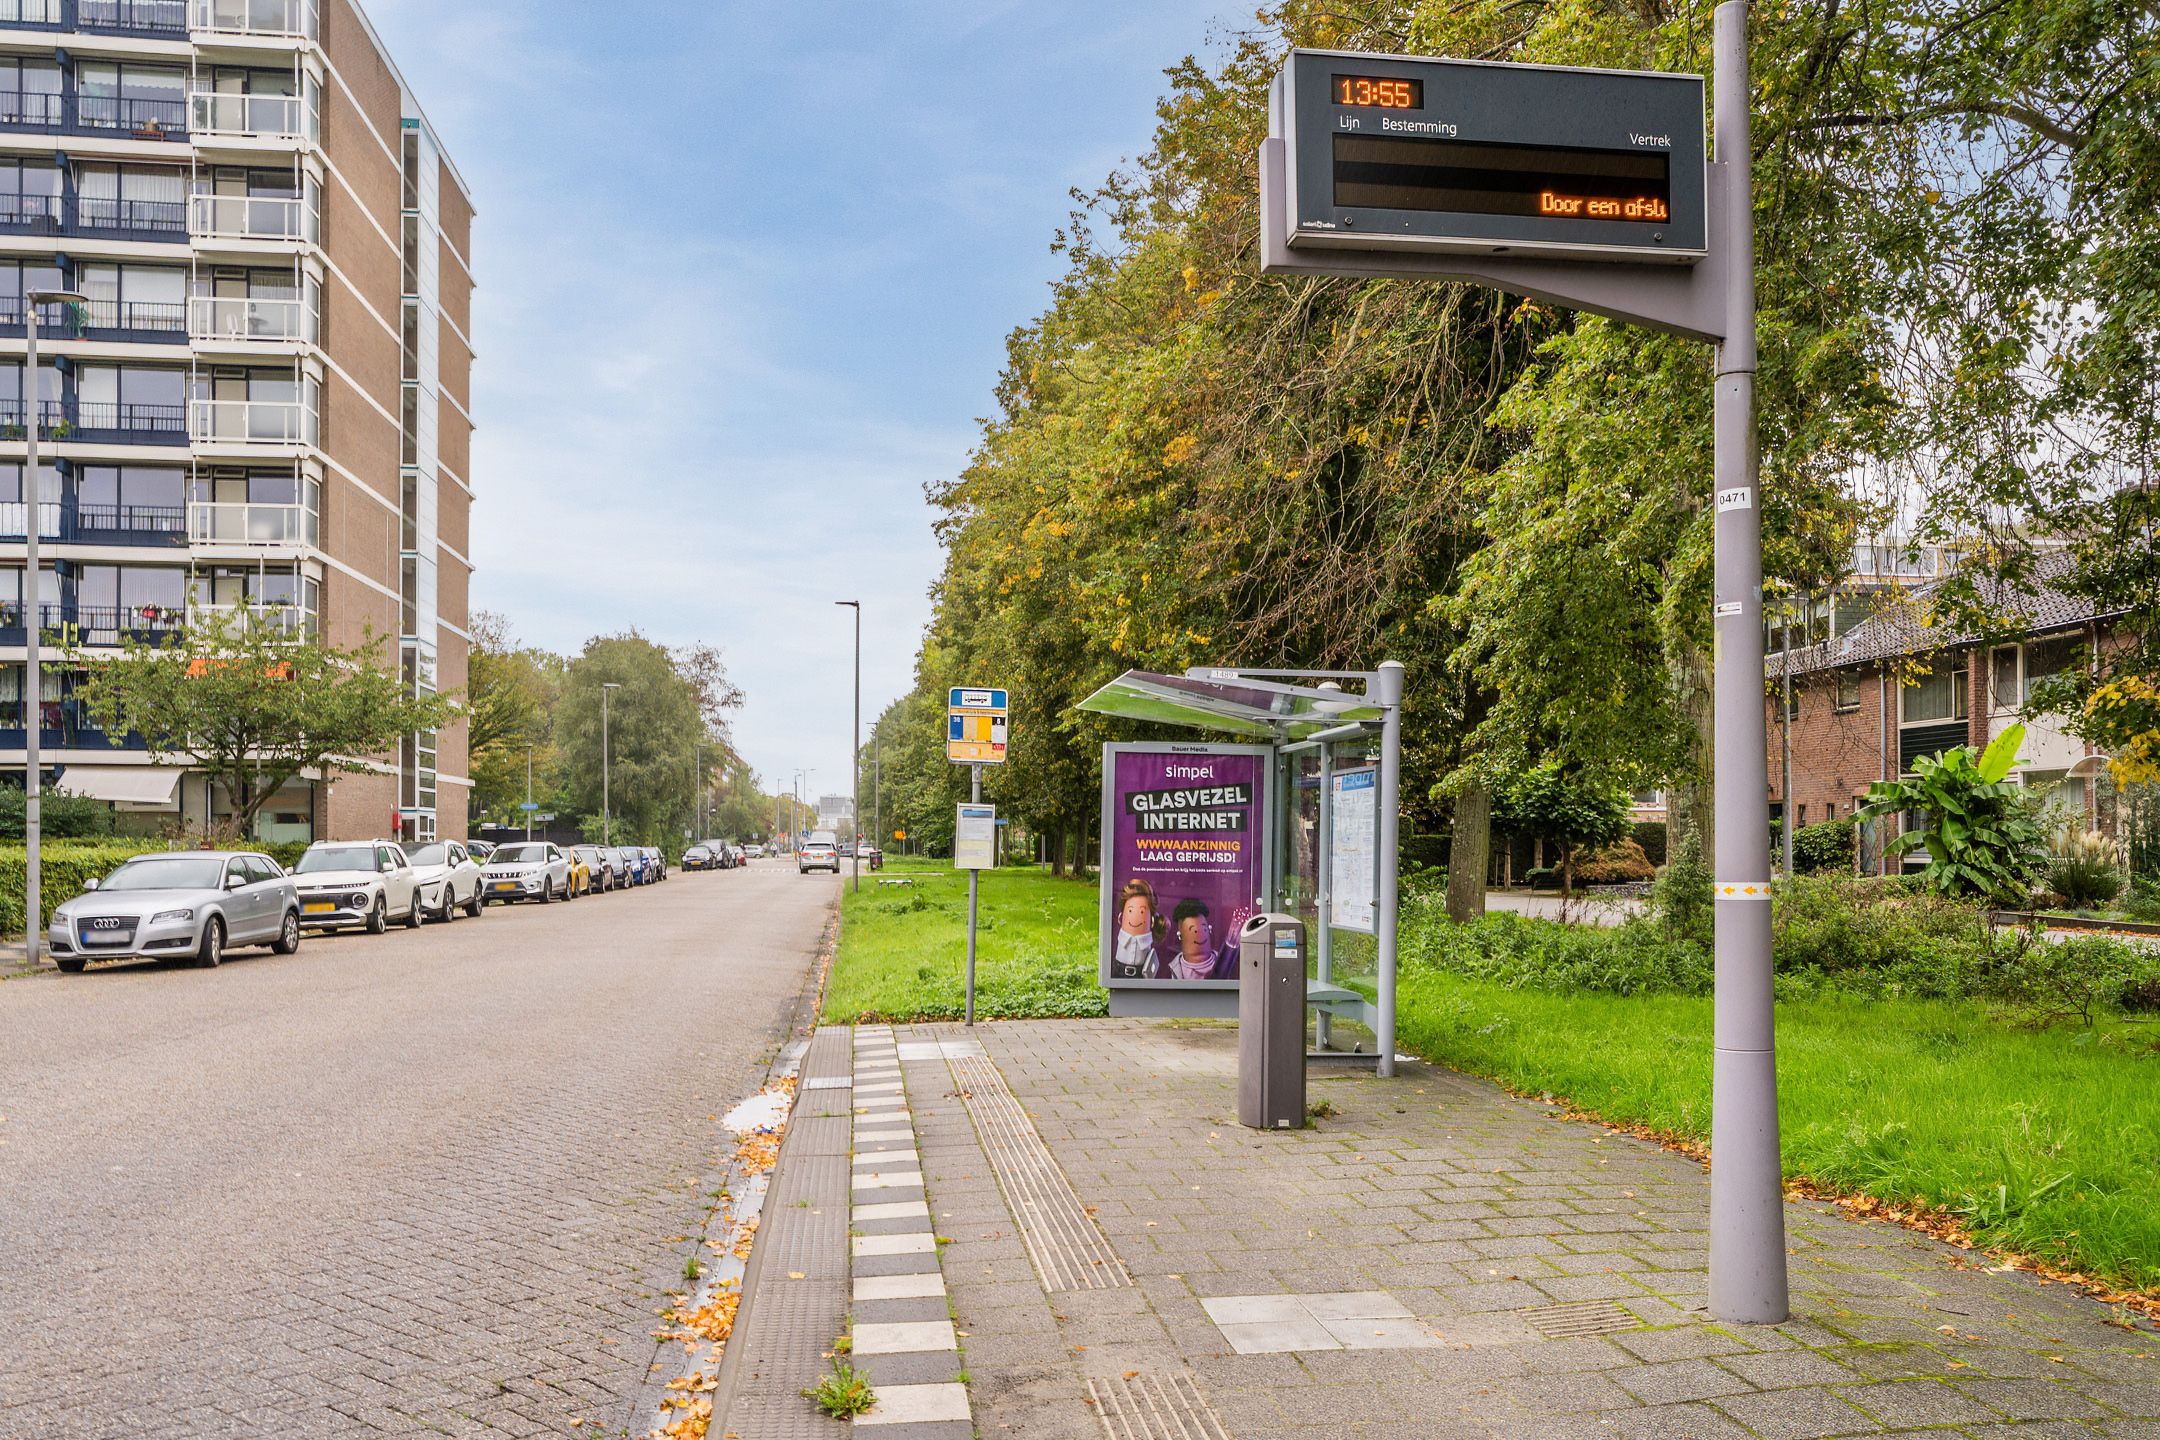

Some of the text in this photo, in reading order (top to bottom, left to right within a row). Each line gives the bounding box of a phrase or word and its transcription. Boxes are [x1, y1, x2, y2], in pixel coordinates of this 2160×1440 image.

[1342, 79, 1410, 108] 13:55
[1340, 115, 1458, 137] Lijn Bestemming
[1629, 132, 1671, 147] Vertrek
[1541, 192, 1582, 213] Door
[1587, 200, 1620, 215] een
[1719, 492, 1745, 504] 0471
[1165, 764, 1214, 780] simpel
[1132, 786, 1247, 811] GLASVEZEL
[1143, 812, 1241, 830] INTERNET
[1136, 839, 1241, 851] WWWAANZINNIG
[1140, 851, 1236, 863] LAAG GEPRIJSD!
